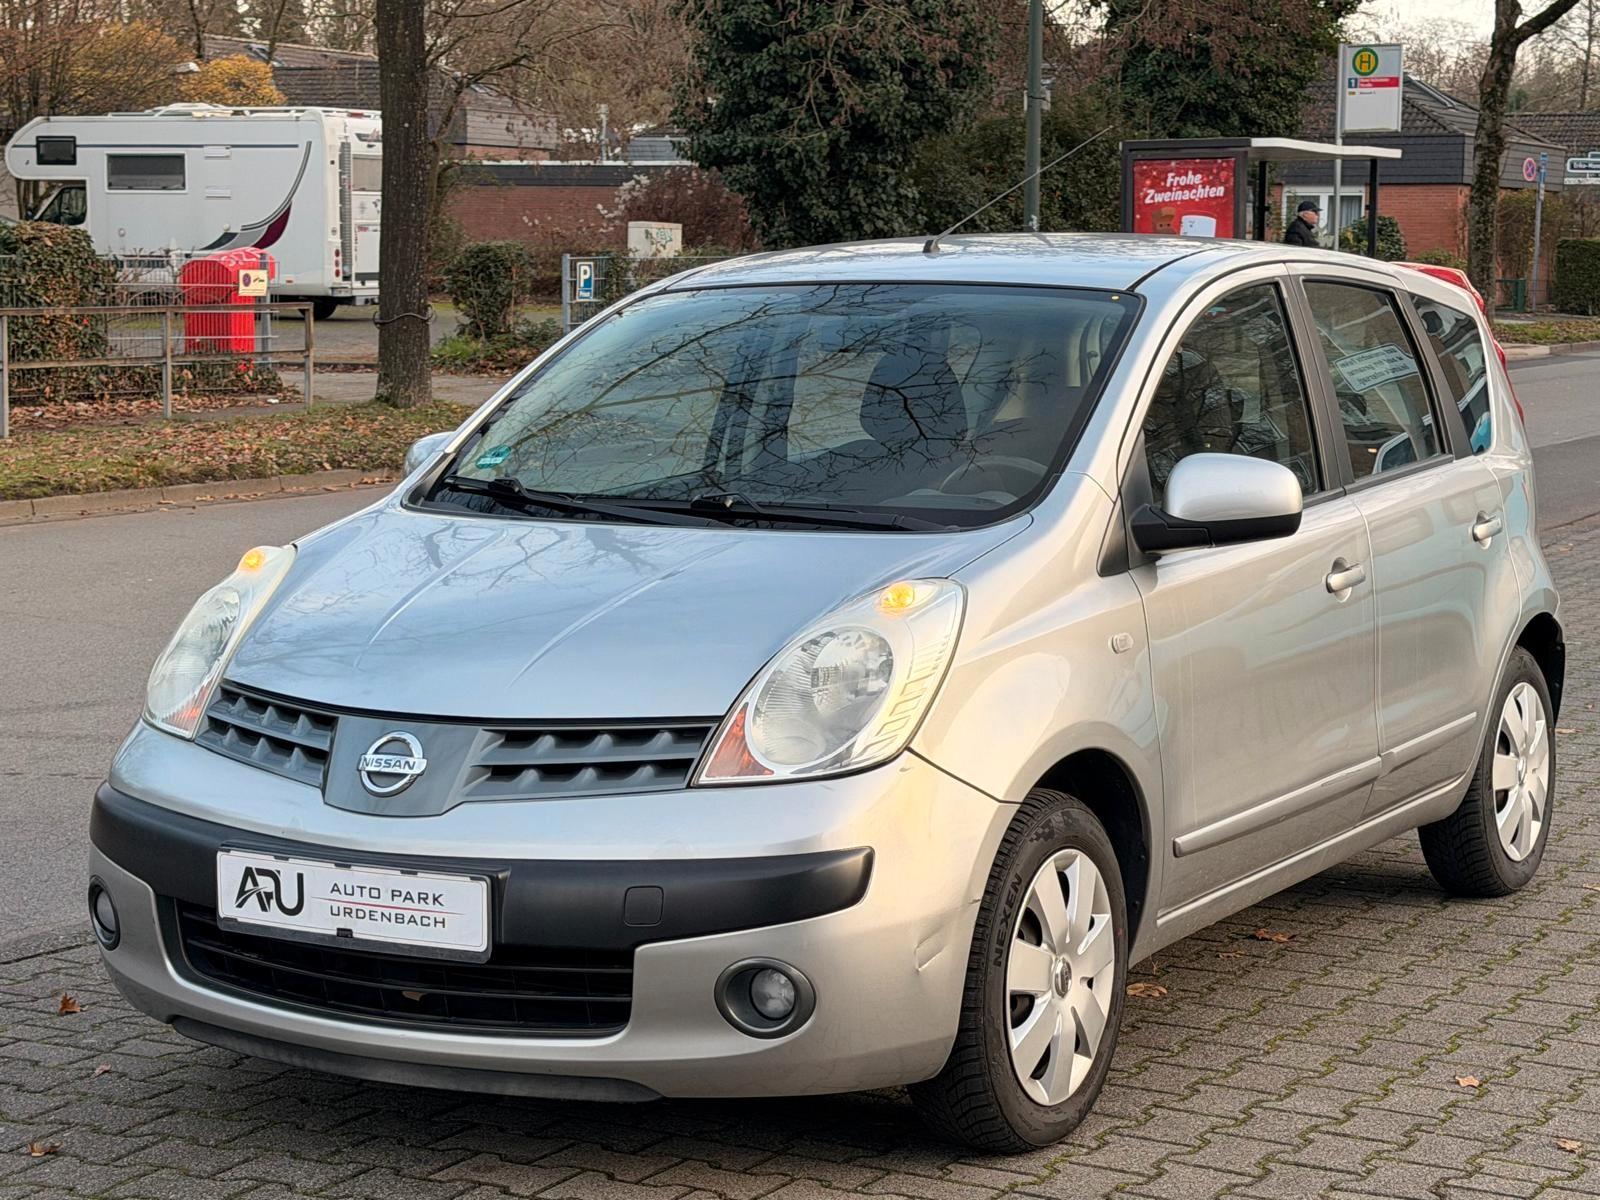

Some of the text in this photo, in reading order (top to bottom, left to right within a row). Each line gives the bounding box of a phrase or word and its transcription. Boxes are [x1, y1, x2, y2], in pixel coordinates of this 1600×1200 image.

[1166, 170, 1203, 187] Frohe
[1144, 185, 1225, 204] Zweinachten
[580, 265, 591, 288] P
[361, 755, 416, 771] NISSAN
[330, 882, 445, 907] AUTO PARK
[330, 905, 446, 929] URDENBACH
[993, 872, 1023, 968] NEXEN
